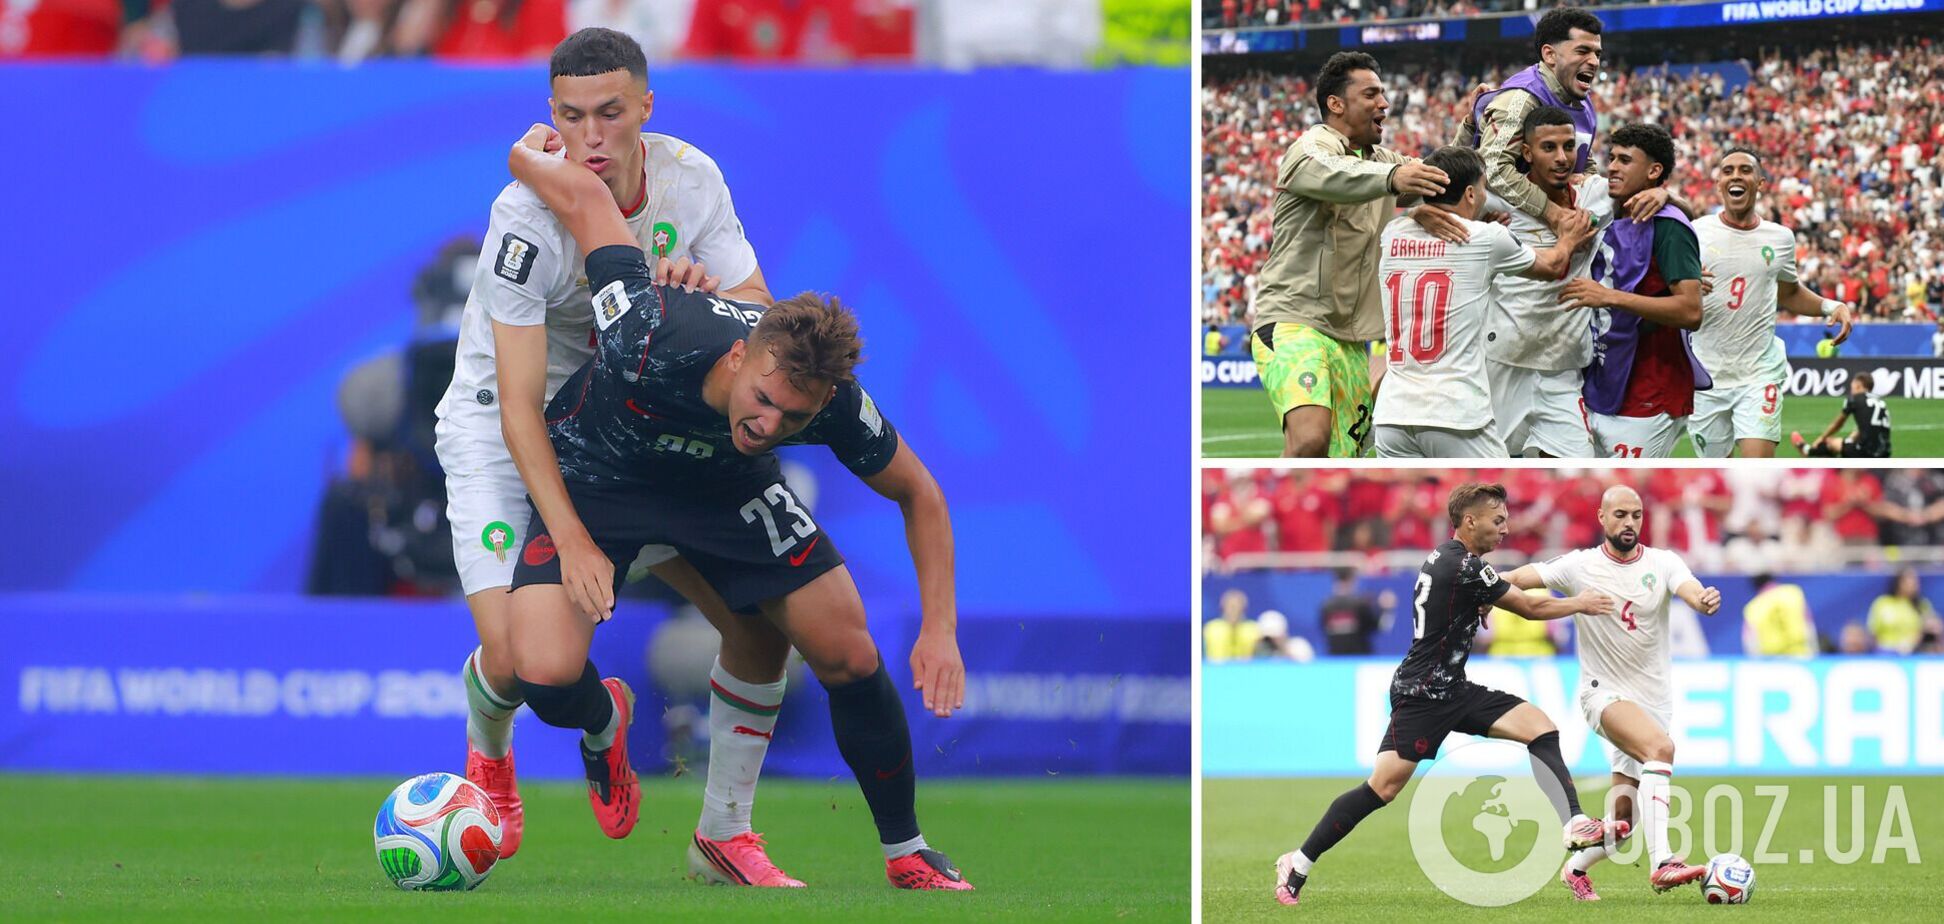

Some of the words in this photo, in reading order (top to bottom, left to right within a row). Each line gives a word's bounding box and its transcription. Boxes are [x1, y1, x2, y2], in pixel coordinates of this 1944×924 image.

[1722, 3, 1761, 22] FIFA
[1760, 0, 1823, 20] WORLD
[1824, 0, 1860, 14] CUP
[1391, 238, 1446, 257] BRAHIM
[1727, 276, 1746, 310] 9
[1385, 268, 1454, 365] 10
[1217, 360, 1257, 383] CUP
[1761, 383, 1777, 415] 9
[1866, 397, 1891, 428] 23
[739, 482, 817, 557] 23
[1621, 600, 1637, 632] 4
[20, 667, 117, 715] FIFA
[117, 668, 279, 717] WORLD
[281, 669, 372, 717] CUP
